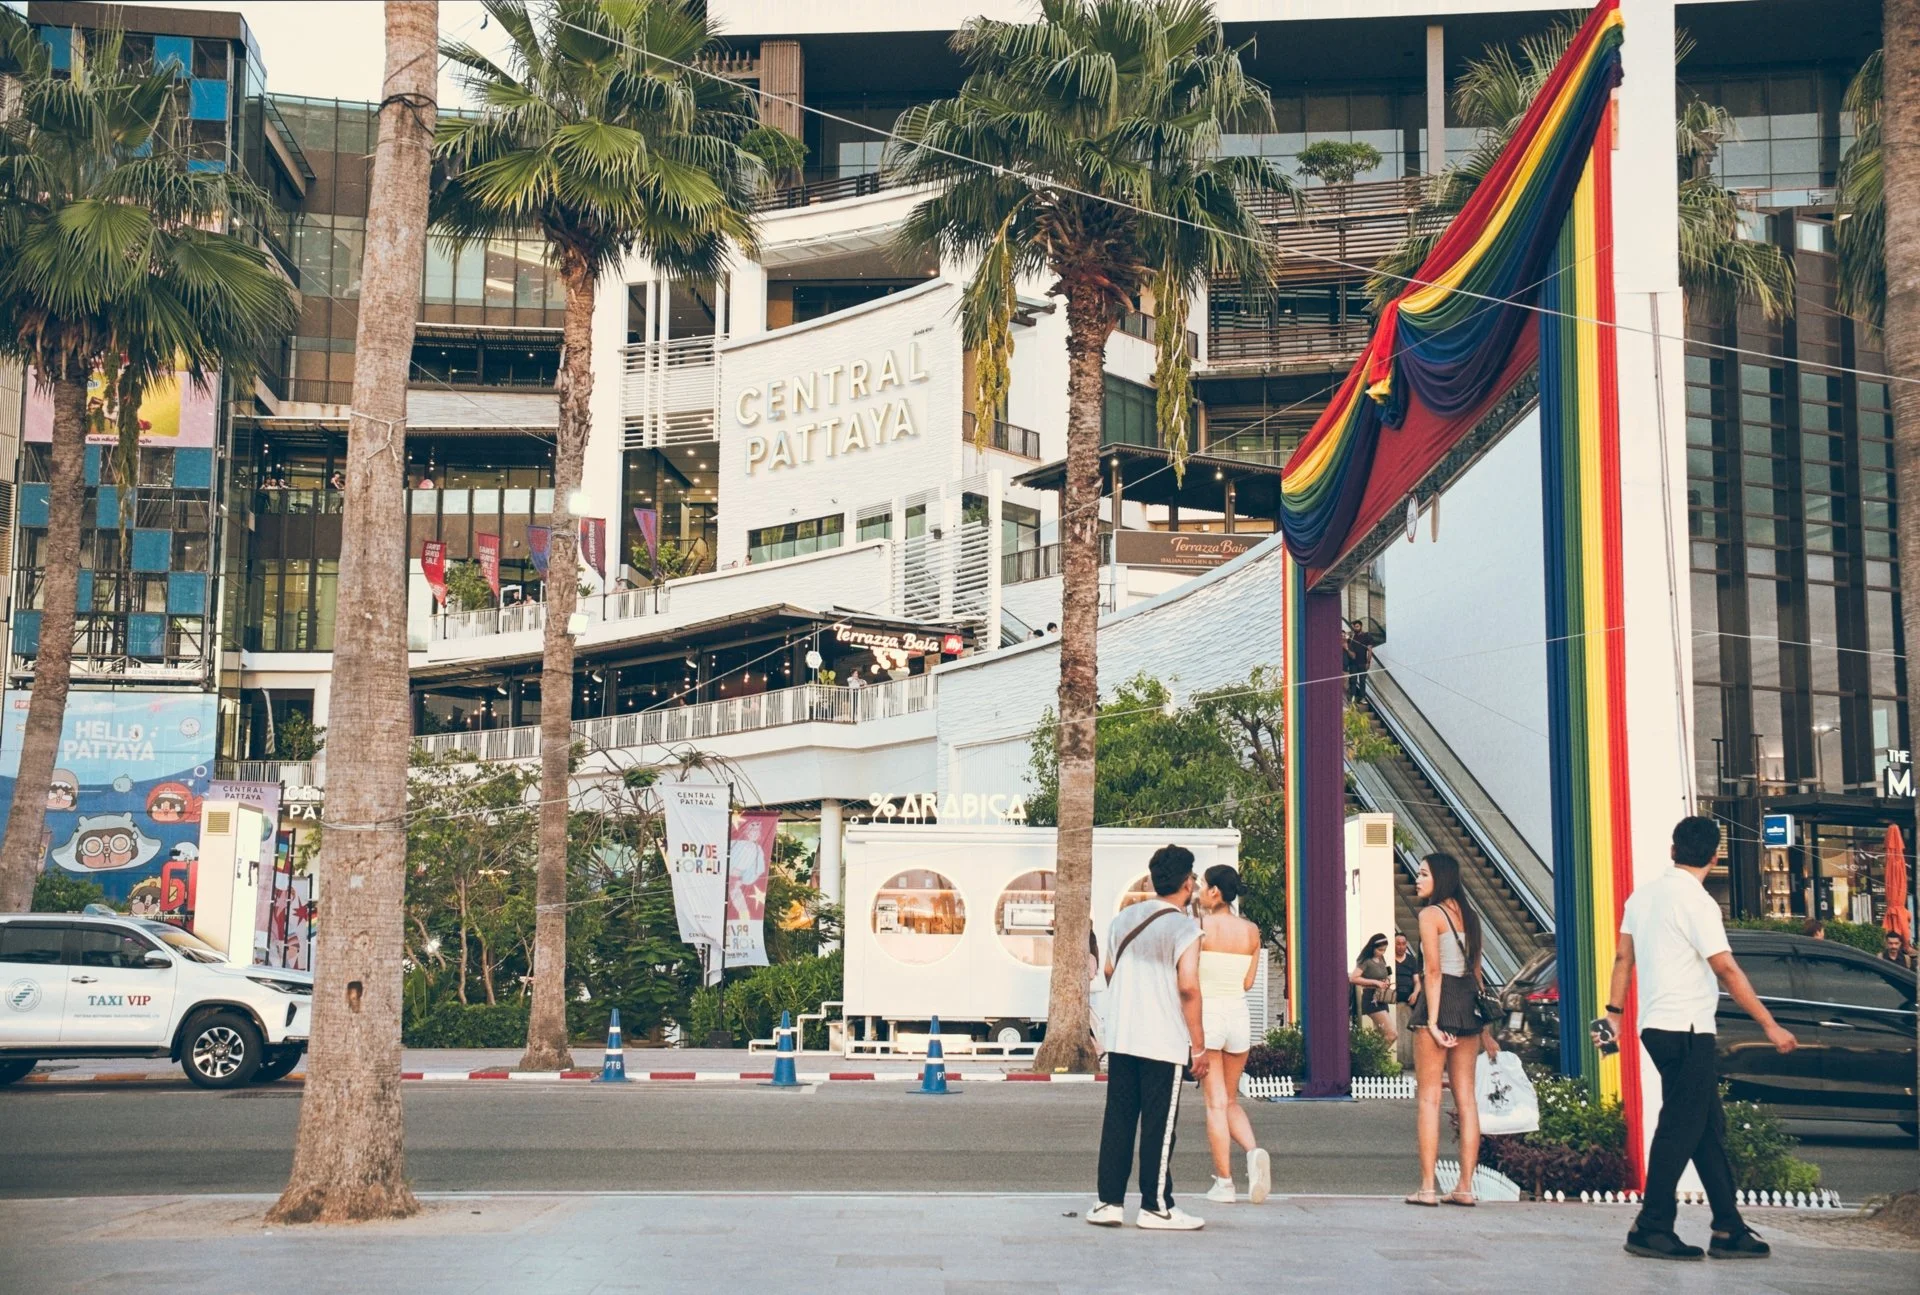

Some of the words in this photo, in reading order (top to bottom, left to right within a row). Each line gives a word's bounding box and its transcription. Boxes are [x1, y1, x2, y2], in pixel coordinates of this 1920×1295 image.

[735, 341, 929, 427] CENTRAL
[744, 397, 919, 476] PATTAYA
[1170, 536, 1220, 553] Terrazza
[833, 623, 898, 648] Terrazza
[75, 720, 144, 742] HELLO
[63, 740, 156, 761] PATTAYA
[1888, 749, 1910, 763] THE
[223, 785, 264, 794] CENTRAL
[1888, 767, 1916, 797] M
[224, 792, 262, 800] PATTAYA
[677, 791, 716, 799] CENTRAL
[680, 798, 714, 806] PATTAYA
[88, 995, 123, 1006] TAXI
[127, 995, 152, 1006] VIP
